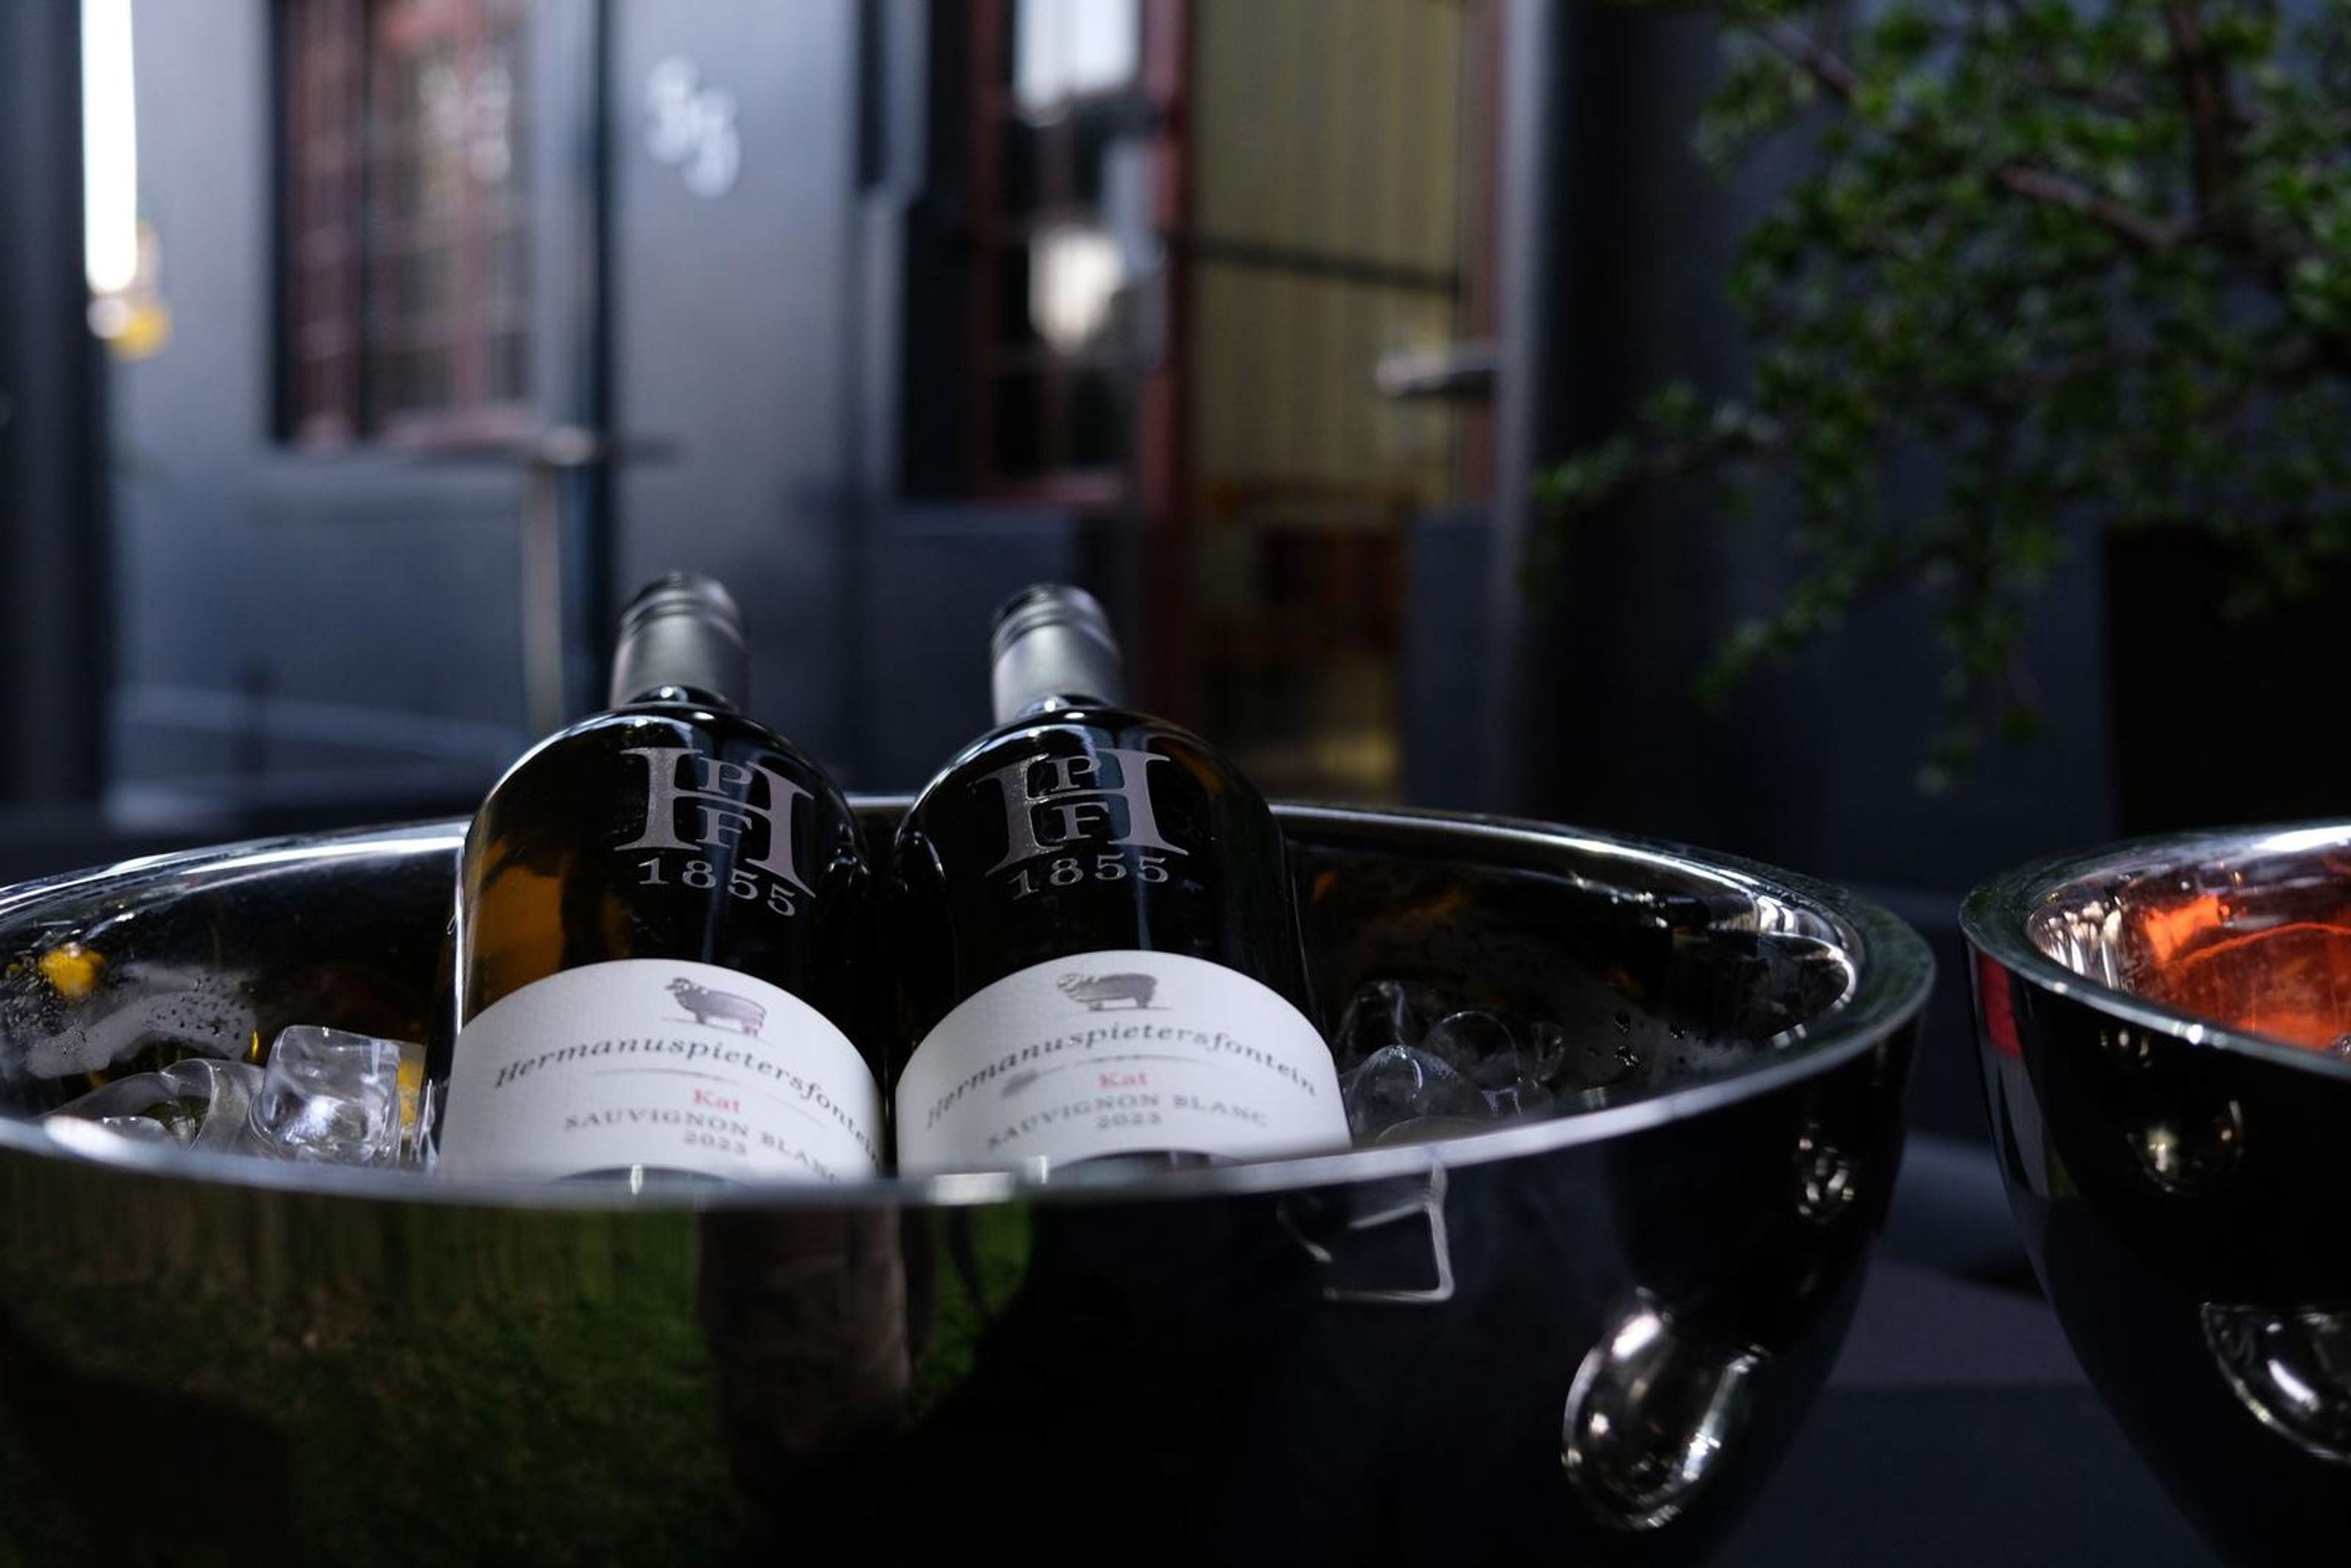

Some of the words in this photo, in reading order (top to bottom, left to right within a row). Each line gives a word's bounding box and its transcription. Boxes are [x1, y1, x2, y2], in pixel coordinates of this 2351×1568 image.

[637, 857, 796, 917] 1855
[1007, 853, 1169, 901] 1855
[926, 1022, 1317, 1129] Hermanuspietersfontein
[1098, 1071, 1148, 1088] Kat
[693, 1088, 741, 1113] Kat
[565, 1108, 749, 1138] SAUVIGNON
[987, 1093, 1160, 1149] SAUVIGNON
[1172, 1093, 1268, 1127] BLANC
[683, 1129, 748, 1156] 2023
